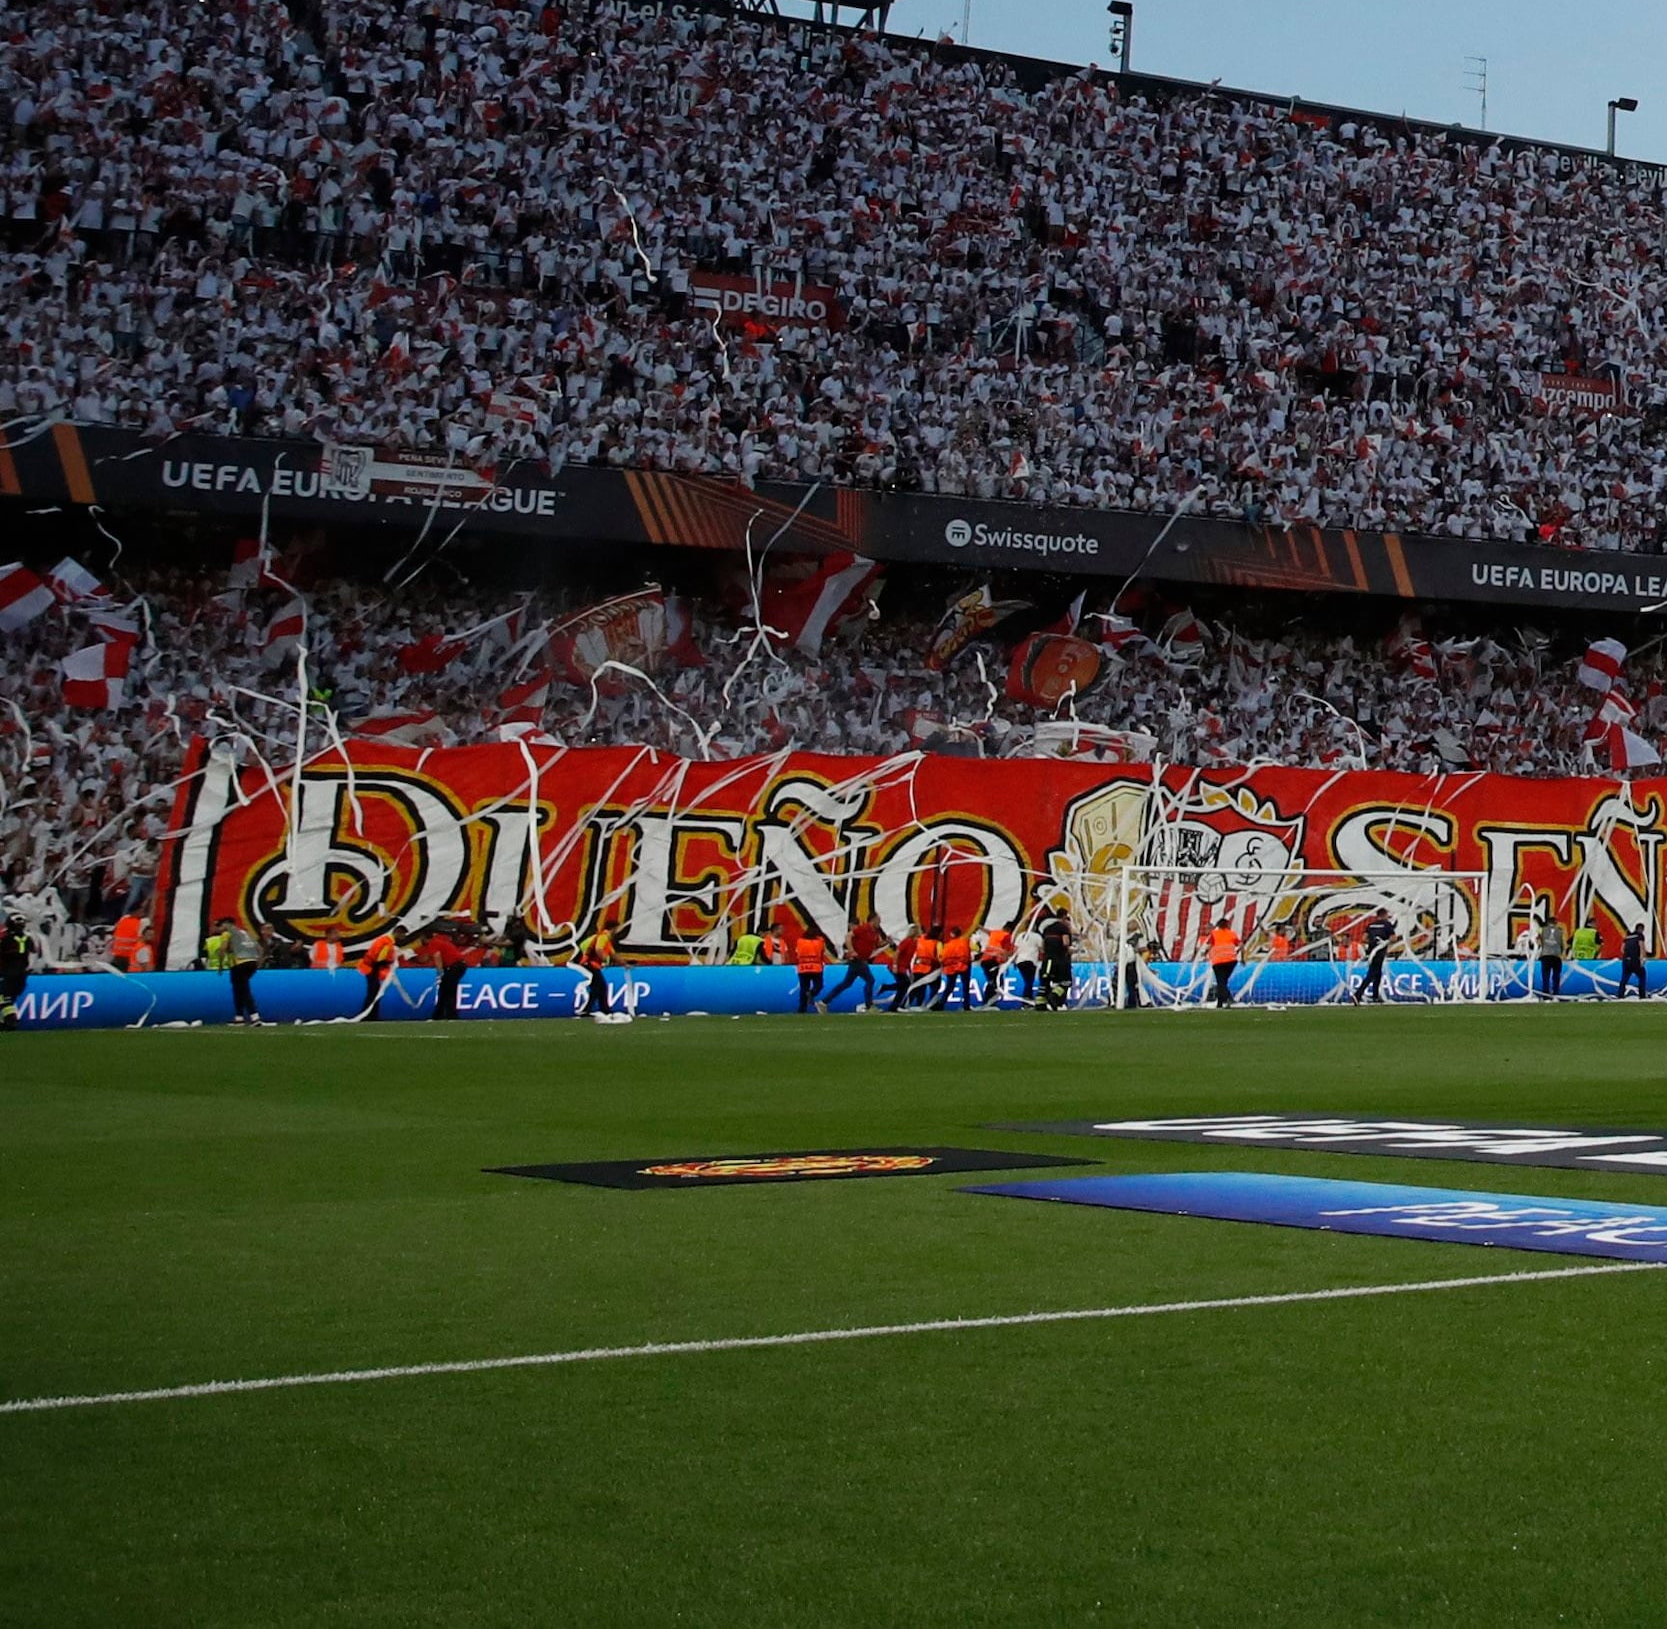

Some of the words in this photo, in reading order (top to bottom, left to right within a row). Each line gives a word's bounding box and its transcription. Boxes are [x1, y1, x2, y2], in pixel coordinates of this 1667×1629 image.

[723, 289, 827, 320] DEGIRO
[161, 459, 261, 494] UEFA
[974, 522, 1099, 556] Swissquote
[1472, 562, 1535, 589] UEFA
[1538, 567, 1629, 596] EUROPA
[250, 772, 1030, 963] DUEÑO
[456, 981, 539, 1010] EACE
[1093, 1114, 1665, 1155] UEFA
